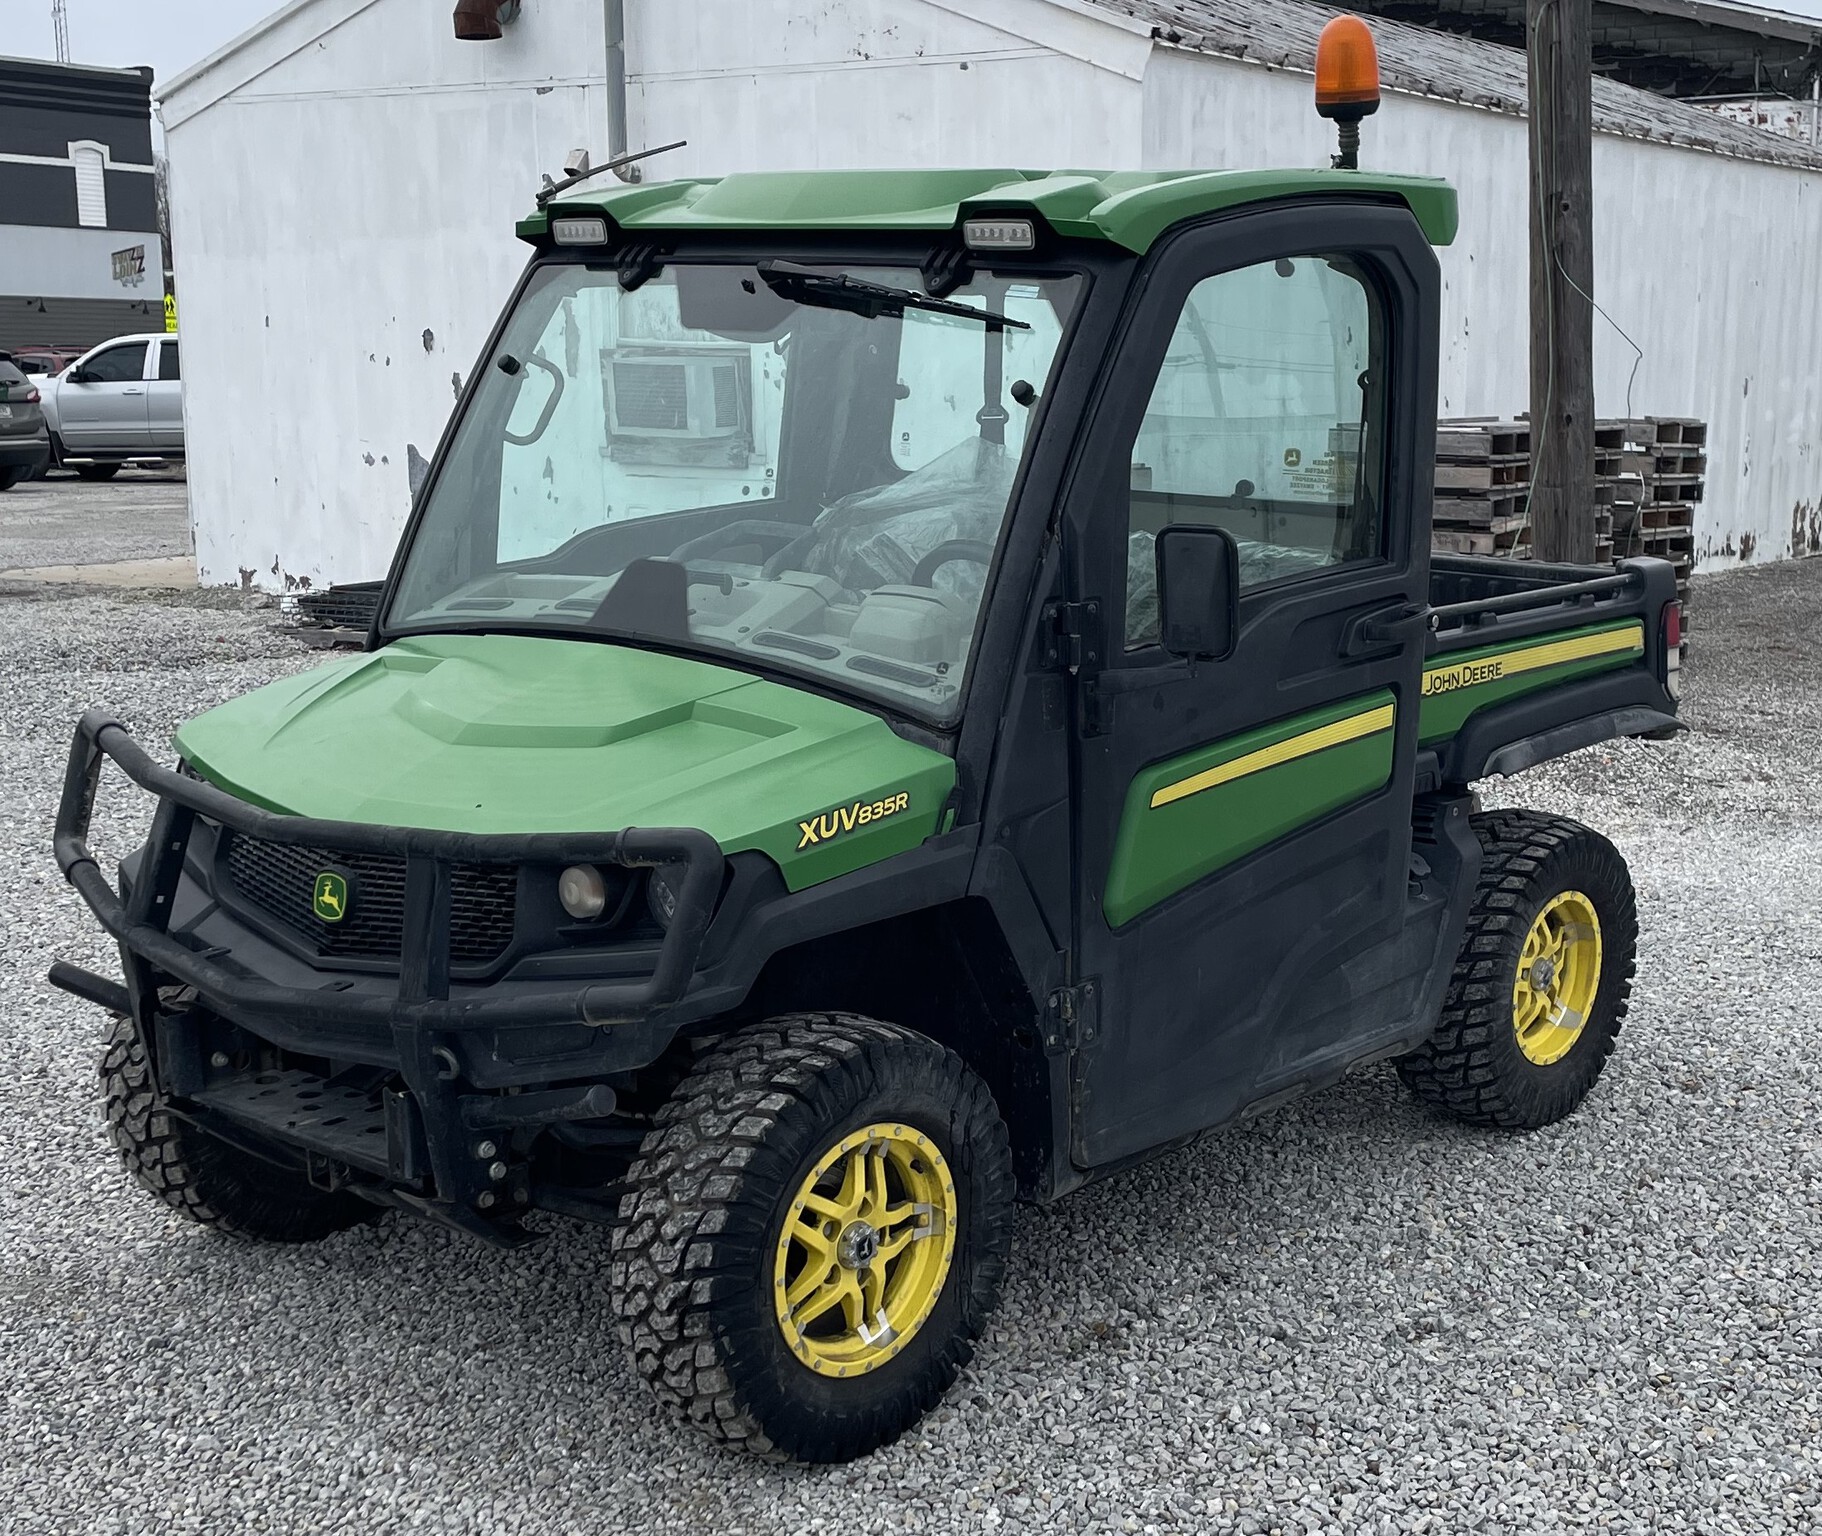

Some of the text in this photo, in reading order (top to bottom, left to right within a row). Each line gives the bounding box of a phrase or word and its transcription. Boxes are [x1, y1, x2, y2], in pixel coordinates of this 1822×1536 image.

[1425, 661, 1503, 693] JOHN DEERE
[797, 791, 909, 850] XUV835R
